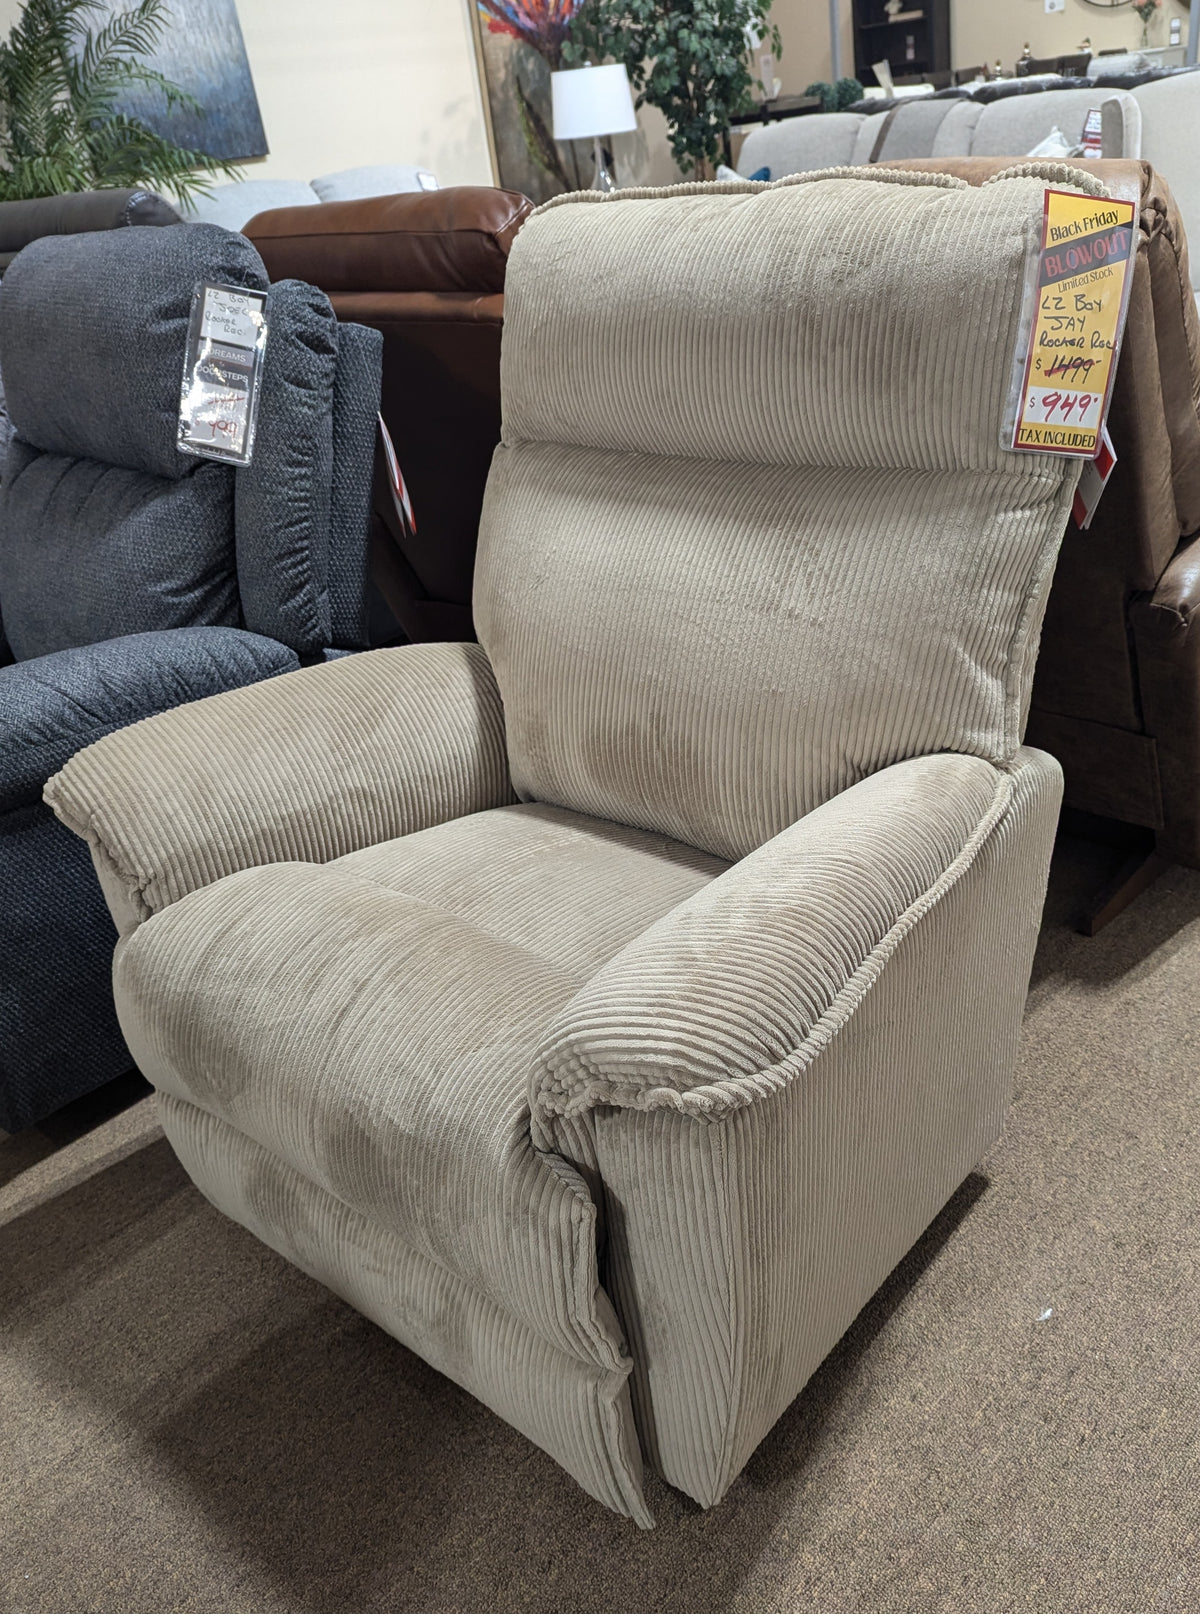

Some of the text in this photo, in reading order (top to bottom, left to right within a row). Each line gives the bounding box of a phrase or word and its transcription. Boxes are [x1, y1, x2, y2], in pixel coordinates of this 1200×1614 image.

[1050, 210, 1119, 242] Black Friday
[1045, 230, 1129, 278] BLOWOUT
[1057, 266, 1114, 293] Limited Stock
[1043, 315, 1086, 332] JAY
[209, 347, 246, 363] DREAMS
[1019, 428, 1096, 448] TAX INCLUDED
